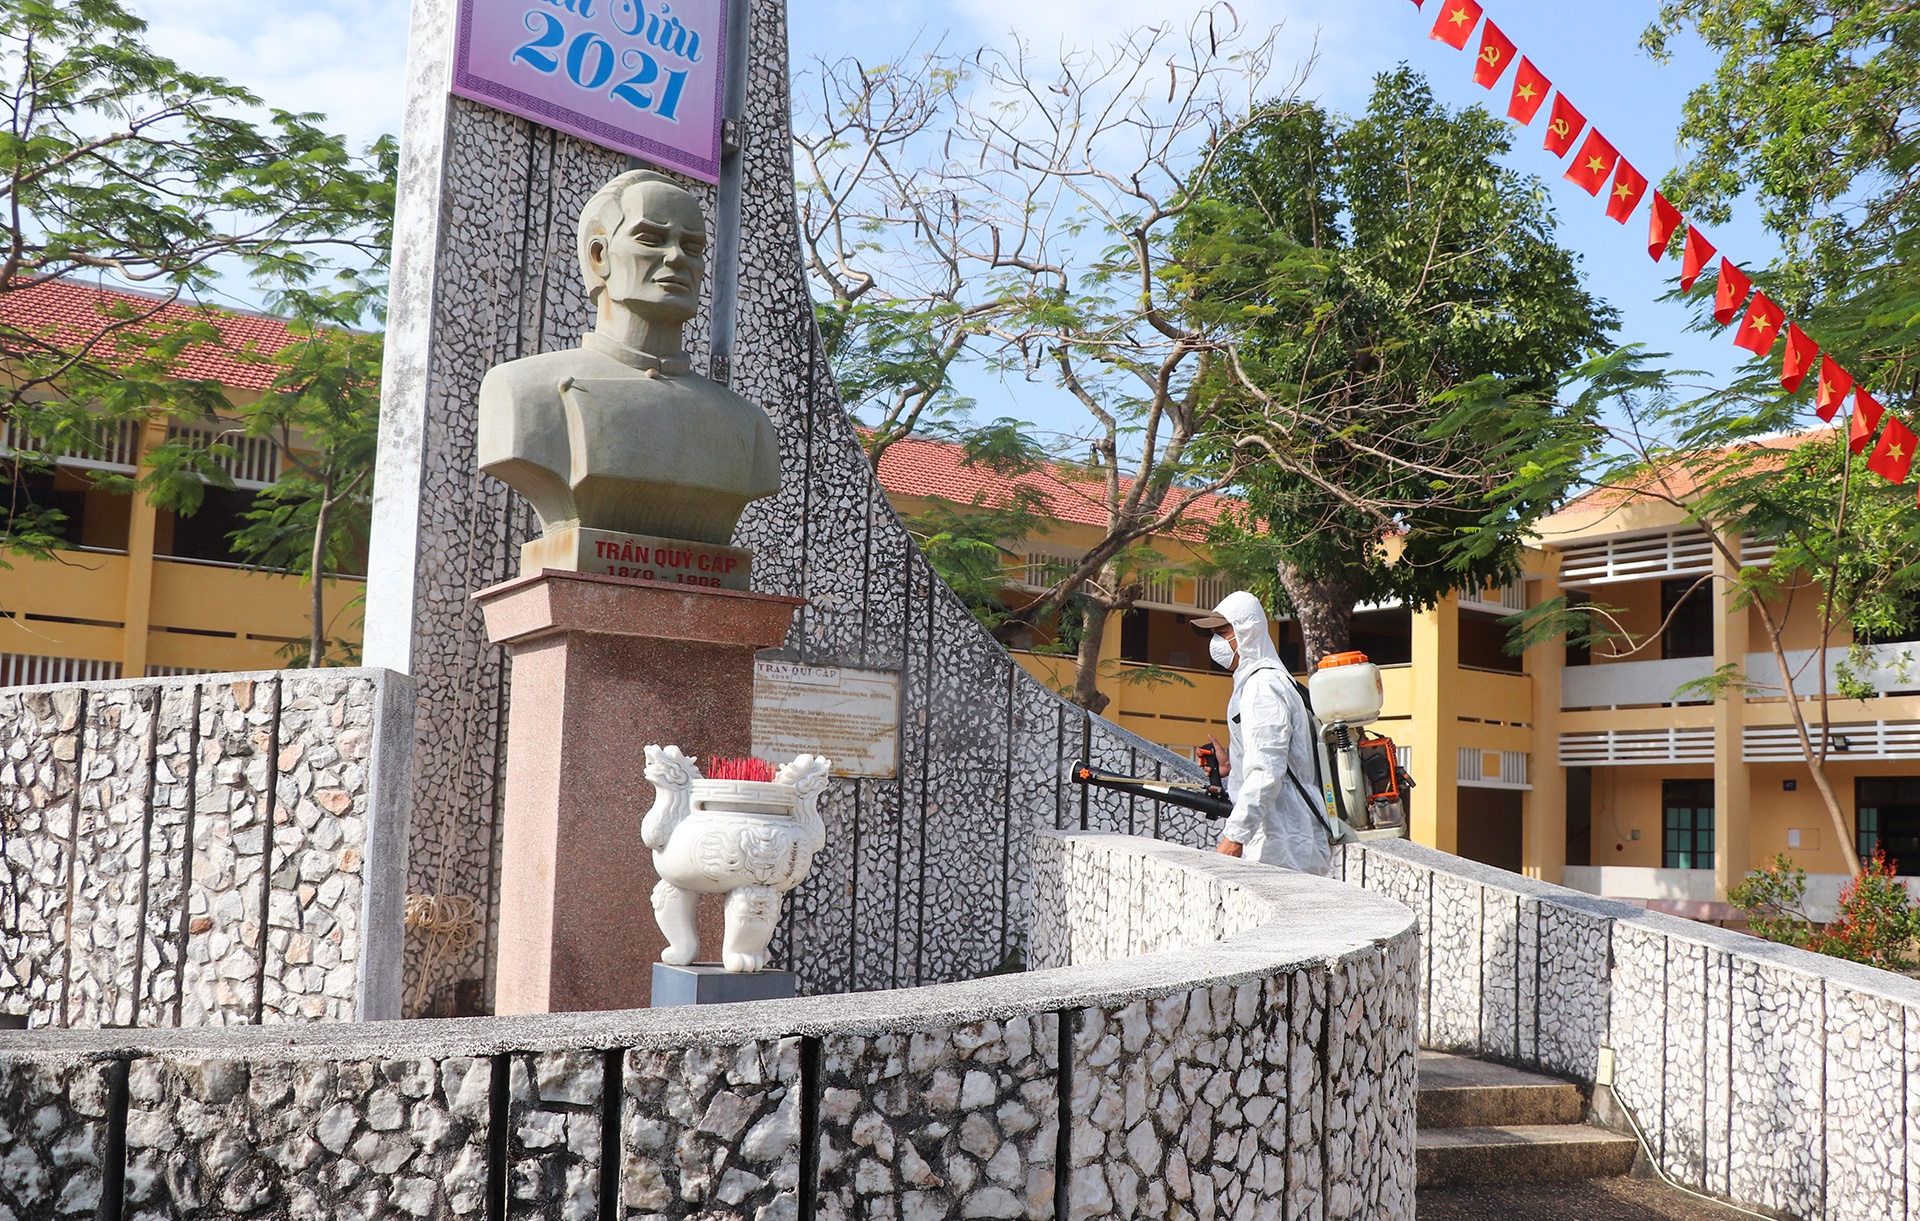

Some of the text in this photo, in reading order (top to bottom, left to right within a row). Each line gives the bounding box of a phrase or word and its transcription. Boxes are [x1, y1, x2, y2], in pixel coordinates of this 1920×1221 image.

[513, 11, 689, 121] 2021
[595, 539, 649, 564] TRẦN
[607, 566, 654, 580] 1870
[676, 573, 721, 588] 1908
